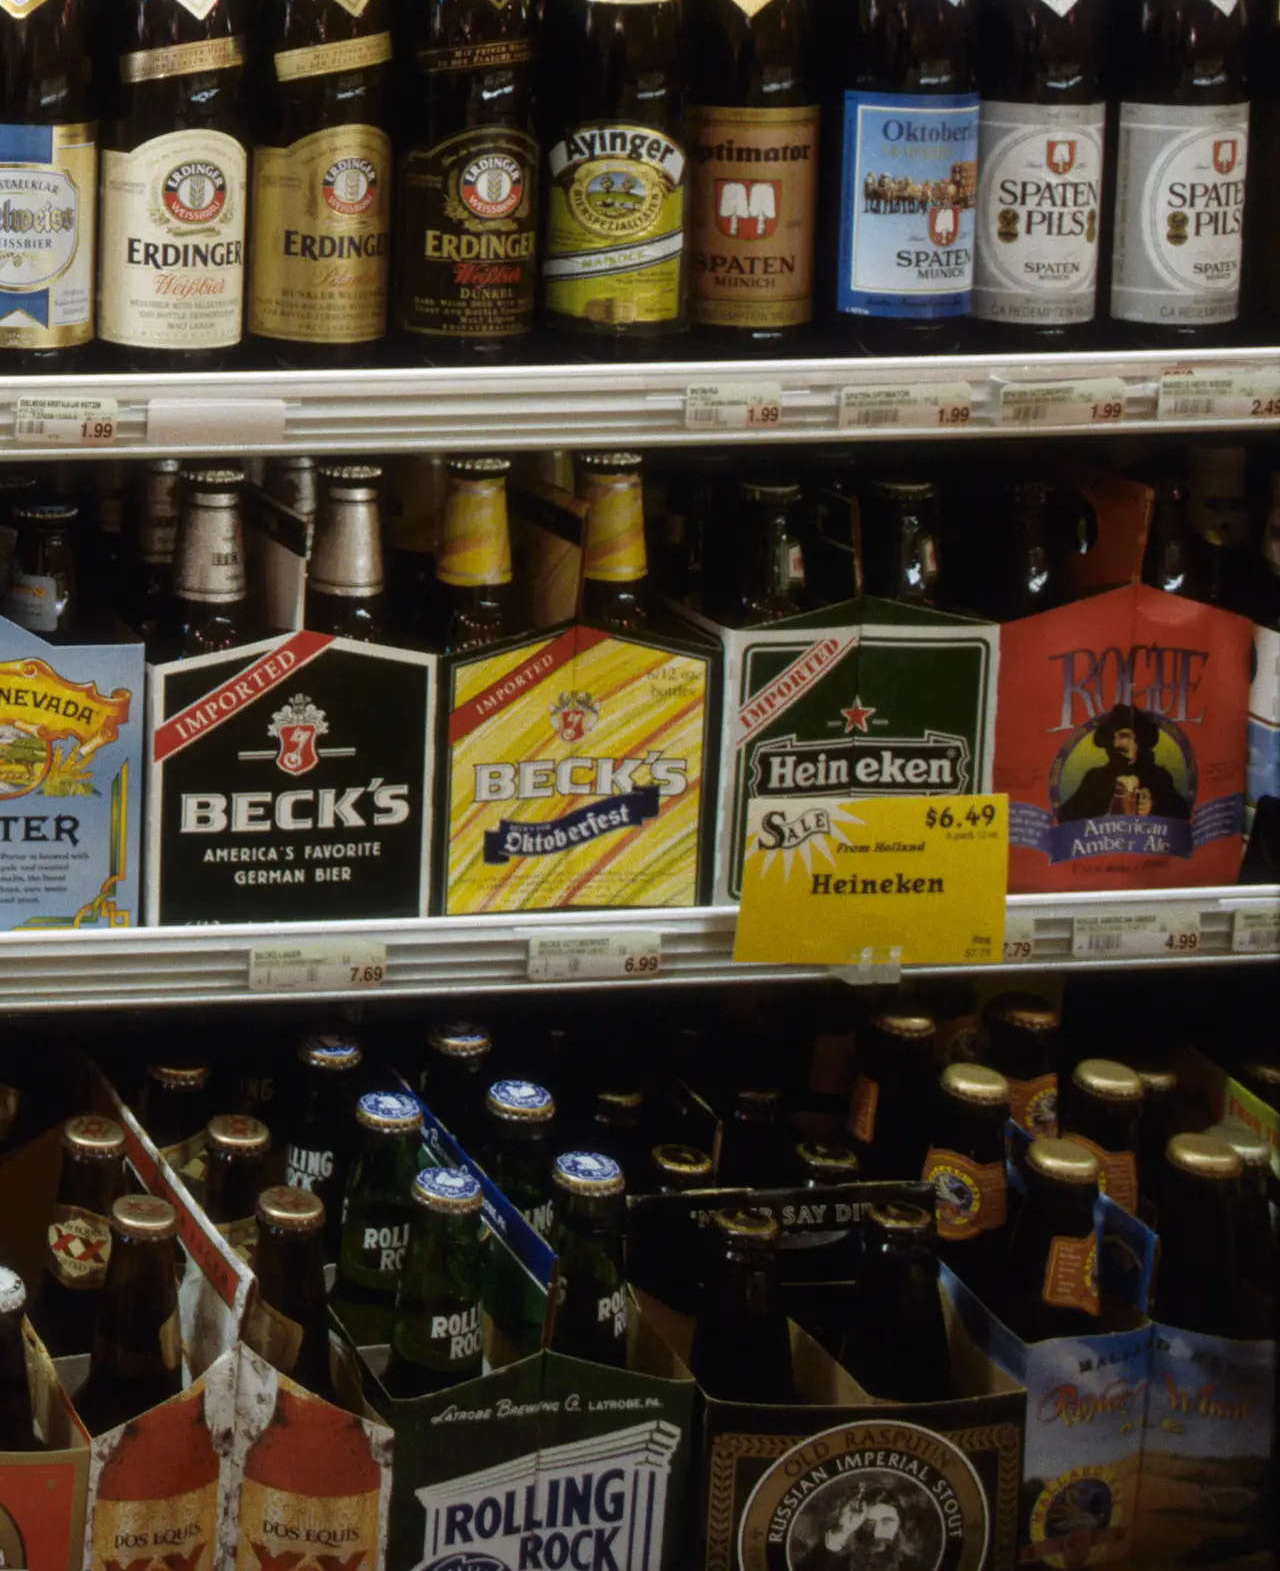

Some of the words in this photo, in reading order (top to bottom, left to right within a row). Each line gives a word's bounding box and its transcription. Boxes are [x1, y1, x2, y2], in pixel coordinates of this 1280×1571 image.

[564, 129, 676, 164] Ayinger
[998, 179, 1098, 208] SPATEN
[1025, 210, 1085, 237] PILS
[126, 238, 242, 269] ERDINGER
[937, 406, 970, 424] 1.99
[174, 649, 297, 740] IMPORTED
[473, 750, 688, 804] BECK'S
[767, 750, 954, 790] Heineken
[180, 777, 410, 834] BECK'S
[925, 804, 996, 829] $6.49
[1082, 818, 1168, 840] American
[203, 843, 295, 863] AMERICA'S
[304, 841, 381, 860] FAVORITE
[836, 843, 870, 855] From
[874, 841, 926, 853] Holland
[234, 867, 306, 886] GERMAN
[315, 866, 352, 883] BIER
[810, 872, 945, 896] Heineken
[1165, 934, 1198, 951] 4.99
[445, 1468, 626, 1545] ROLLING
